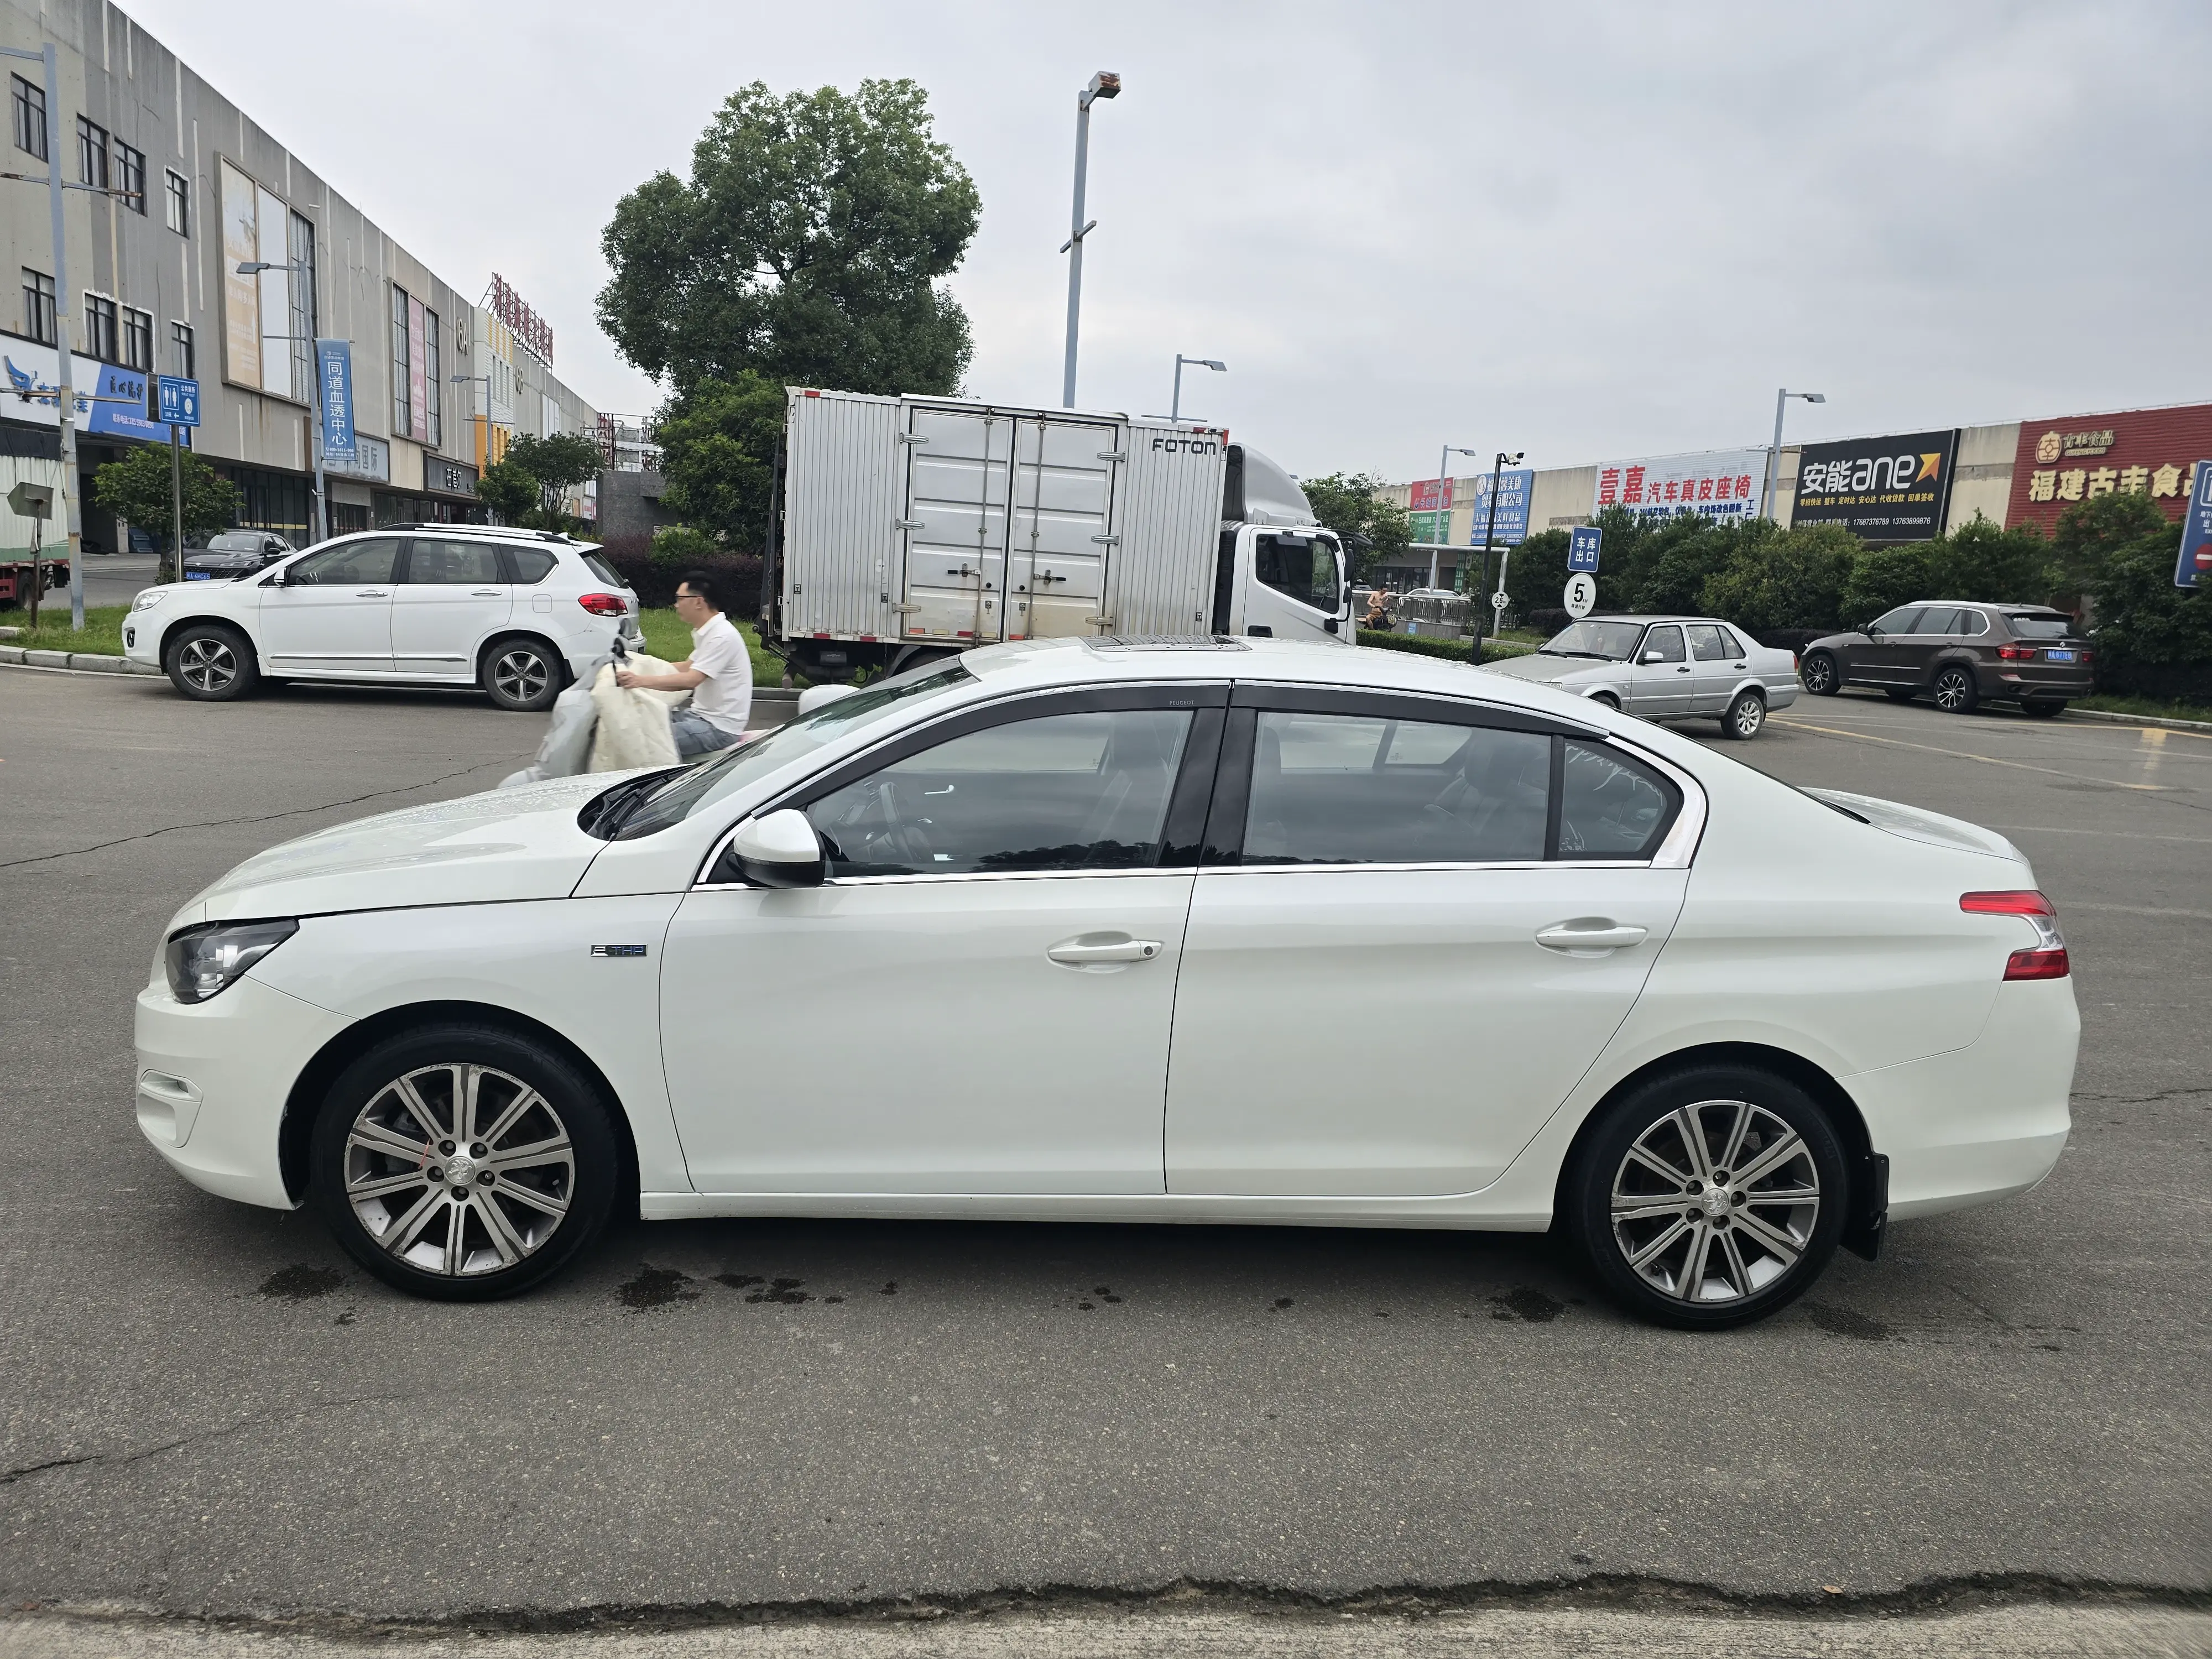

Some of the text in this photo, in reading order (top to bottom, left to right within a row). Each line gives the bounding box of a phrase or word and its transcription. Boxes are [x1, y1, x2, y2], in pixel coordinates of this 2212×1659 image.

[457, 317, 468, 356] 6A
[327, 361, 347, 445] 同道血透中心
[1152, 438, 1216, 455] FOTON
[1598, 465, 1646, 505] 壹嘉
[1647, 474, 1751, 504] 汽车真皮座椅
[1420, 495, 1448, 508] 长城润油
[1800, 492, 1935, 507] 零担快运 整车 定时达 安心达 代收货款 回单签收
[1853, 517, 1889, 526] 17687376789
[1892, 517, 1931, 525] 13763899876
[2203, 519, 2210, 528] 出
[1577, 536, 1597, 550] 车库
[1575, 550, 1594, 562] 出口
[1573, 582, 1585, 602] 5
[611, 946, 644, 955] THP
